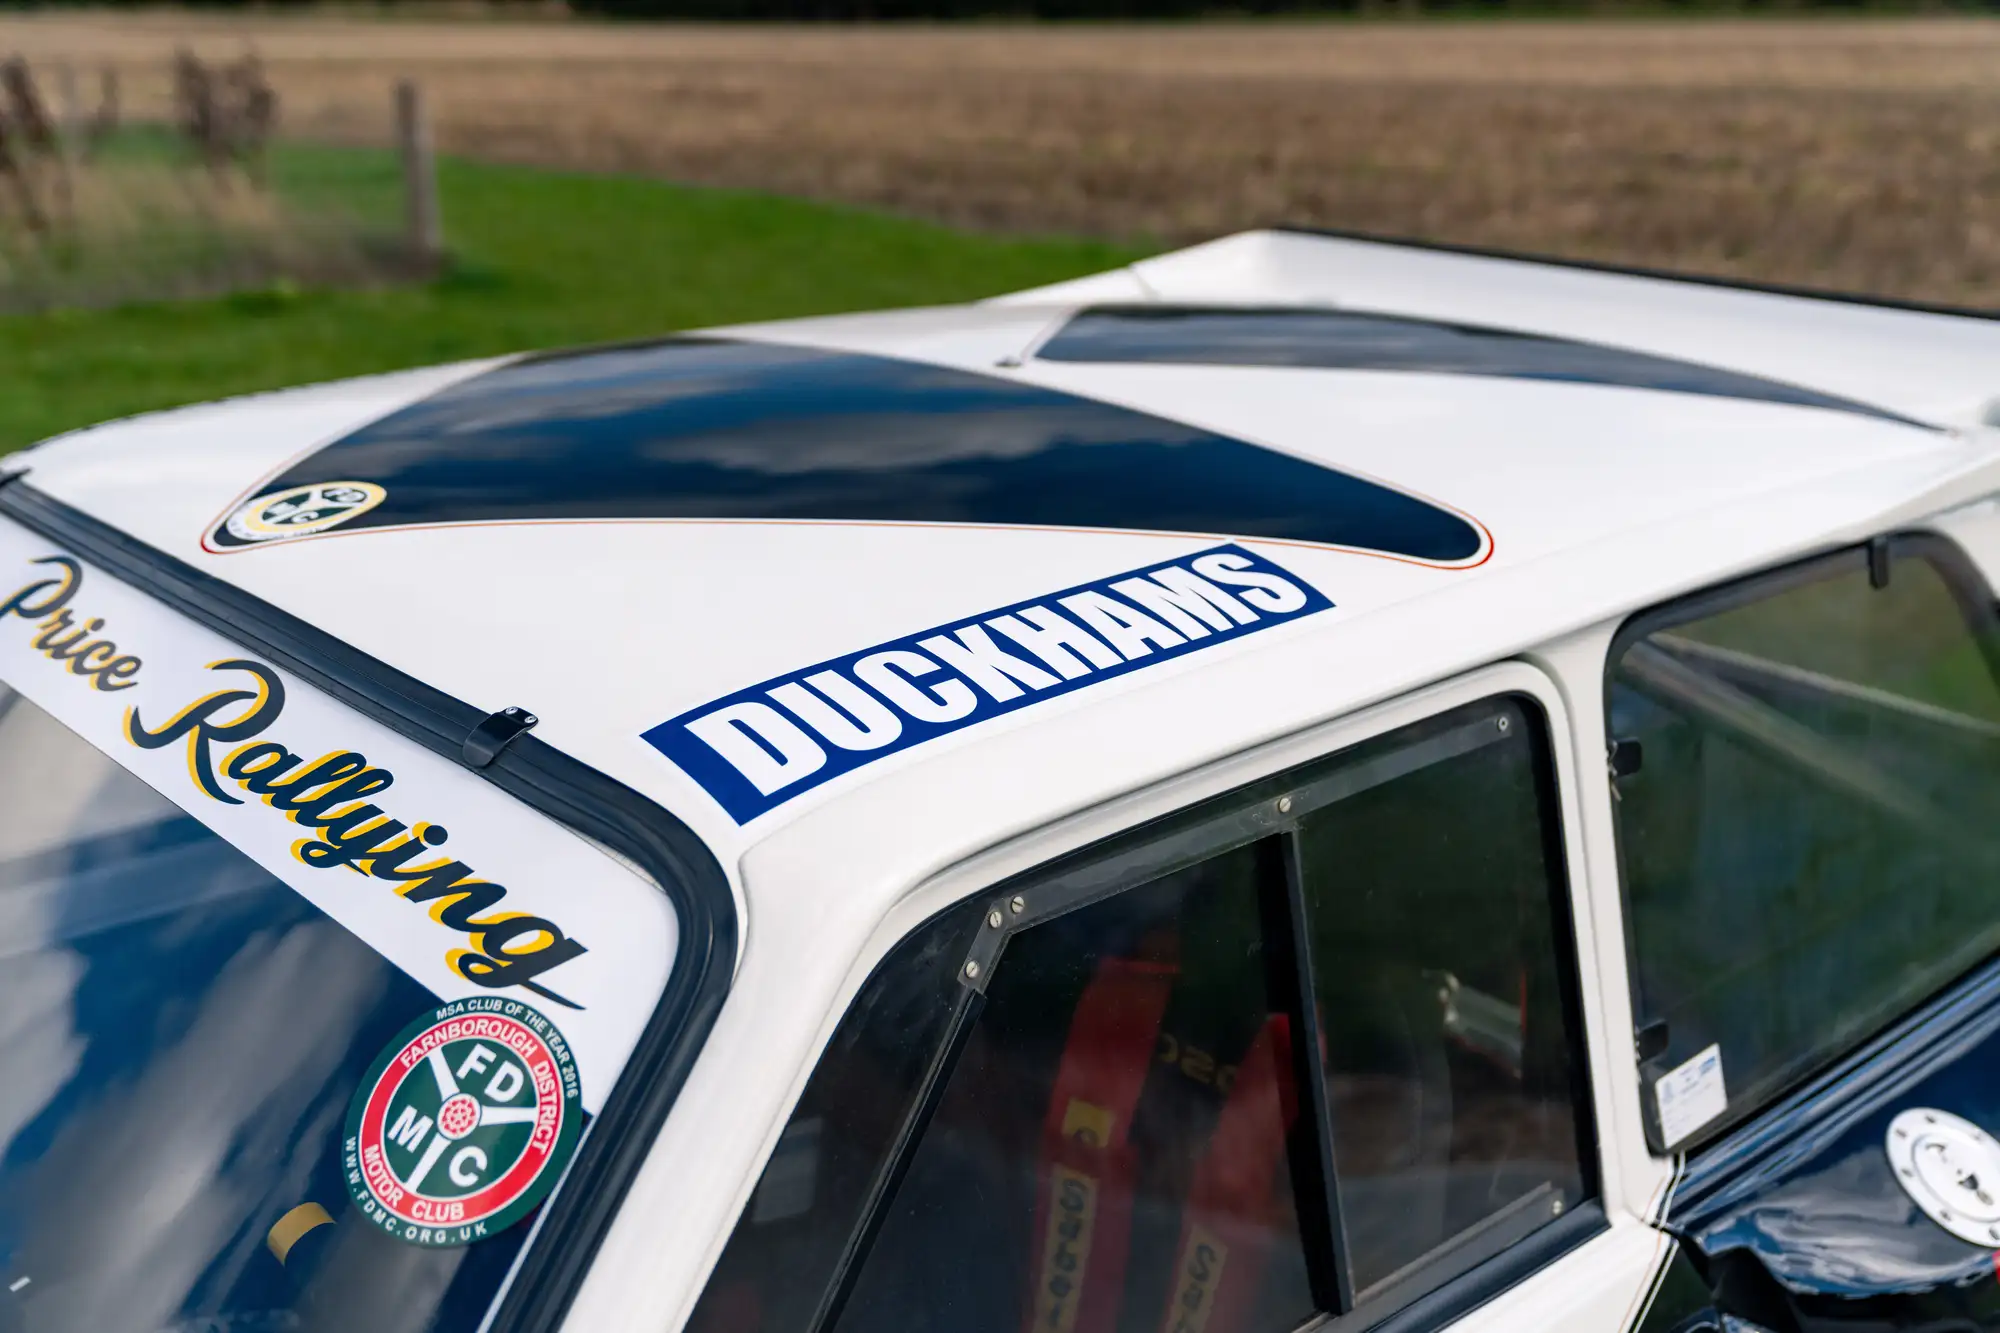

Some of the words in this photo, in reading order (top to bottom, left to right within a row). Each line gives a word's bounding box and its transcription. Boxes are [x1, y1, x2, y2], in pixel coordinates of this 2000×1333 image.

[683, 552, 1309, 798] DUCKHAMS
[0, 554, 143, 693] Price
[122, 657, 590, 1010] Rallying
[400, 1018, 539, 1069] FARNBOROUGH
[532, 1059, 556, 1156] DISTRICT
[436, 1002, 465, 1021] MSA
[467, 998, 503, 1012] CLUB
[505, 1001, 522, 1017] OF
[523, 1007, 548, 1033] THE
[547, 1027, 570, 1063] YEAR
[561, 1063, 579, 1099] 2016
[456, 1043, 525, 1103] FD
[363, 1143, 405, 1207] MOTOR
[411, 1200, 465, 1222] CLUB
